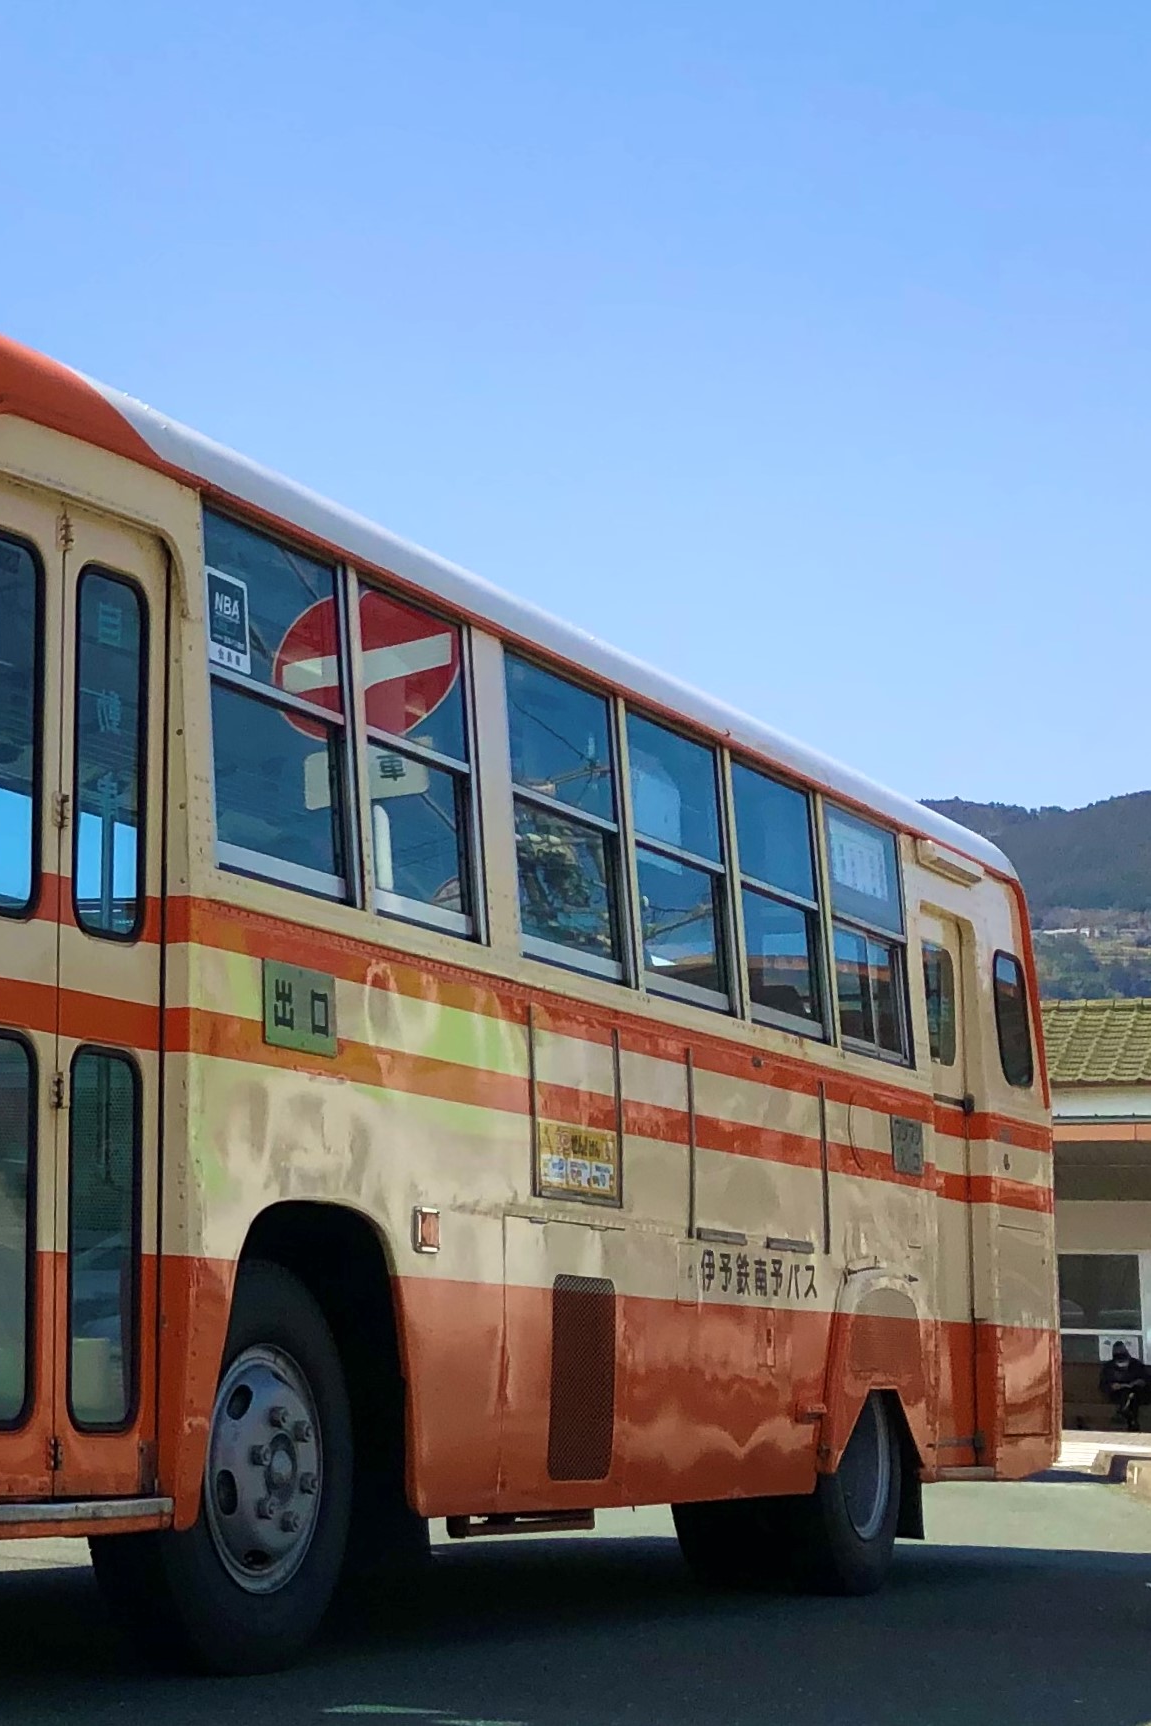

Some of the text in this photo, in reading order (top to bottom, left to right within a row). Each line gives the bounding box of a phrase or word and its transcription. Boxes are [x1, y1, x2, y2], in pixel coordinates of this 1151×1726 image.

[214, 591, 240, 622] NBA
[273, 978, 329, 1039] 出口
[701, 1249, 818, 1300] 伊予鉄南予バス
